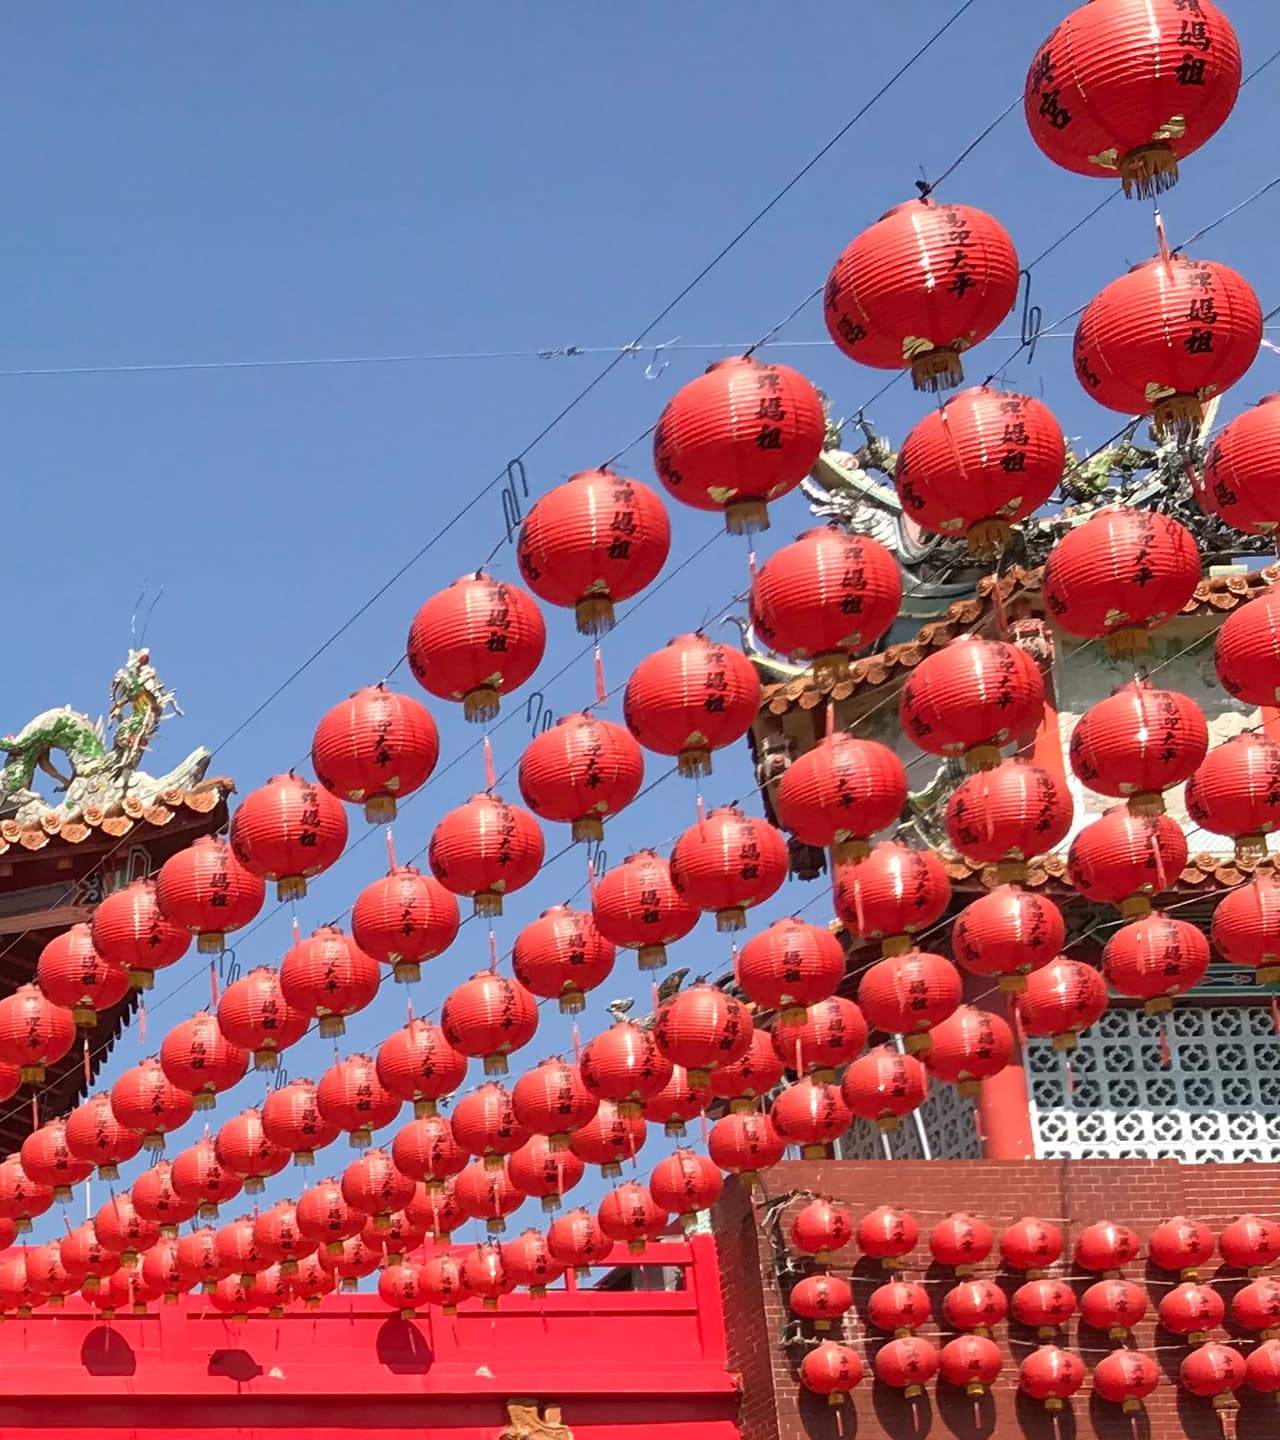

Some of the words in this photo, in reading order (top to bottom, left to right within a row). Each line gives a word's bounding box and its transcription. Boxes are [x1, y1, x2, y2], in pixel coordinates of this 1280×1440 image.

[1184, 263, 1218, 354] 螺媽祖
[754, 364, 786, 449] 螺媽祖
